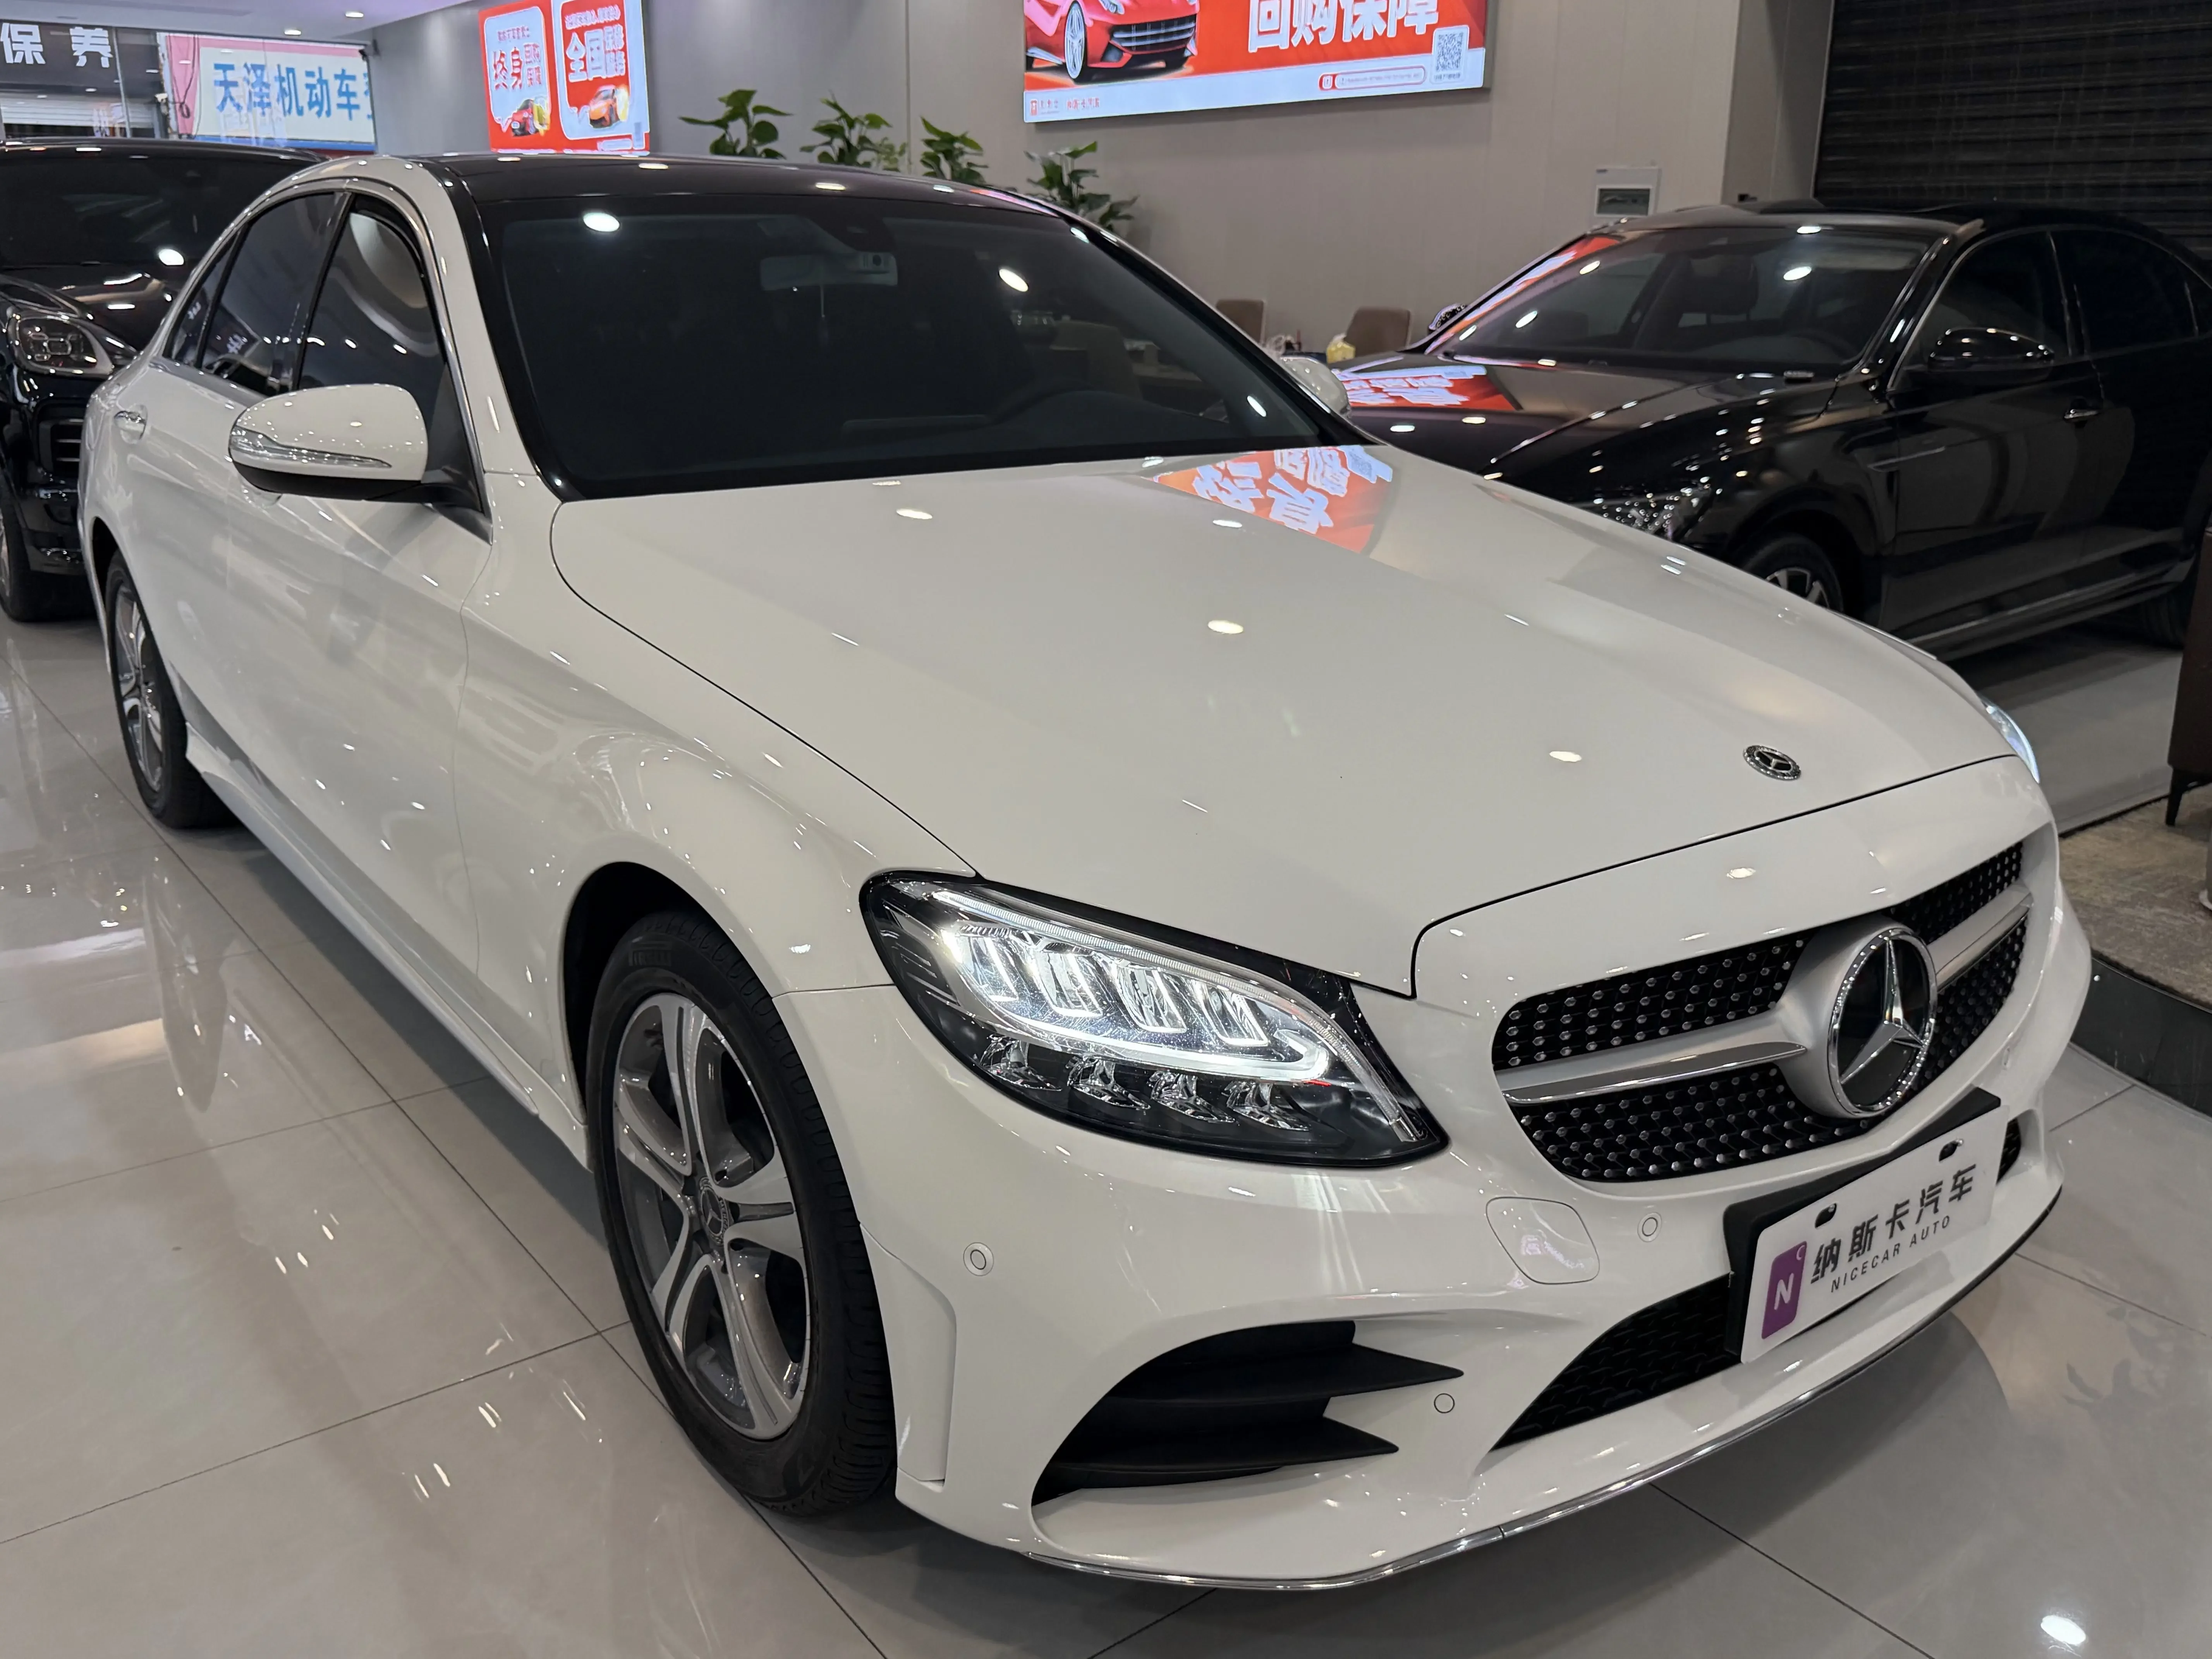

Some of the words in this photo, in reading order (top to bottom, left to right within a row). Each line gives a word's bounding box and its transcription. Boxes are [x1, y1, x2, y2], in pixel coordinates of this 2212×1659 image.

[0, 22, 113, 68] 保养
[213, 62, 373, 121] 天泽机动车
[1810, 1164, 1976, 1284] 纳斯卡汽车
[1831, 1243, 1900, 1292] NICECAR
[1910, 1215, 1950, 1248] AUTO
[1774, 1273, 1794, 1310] N
